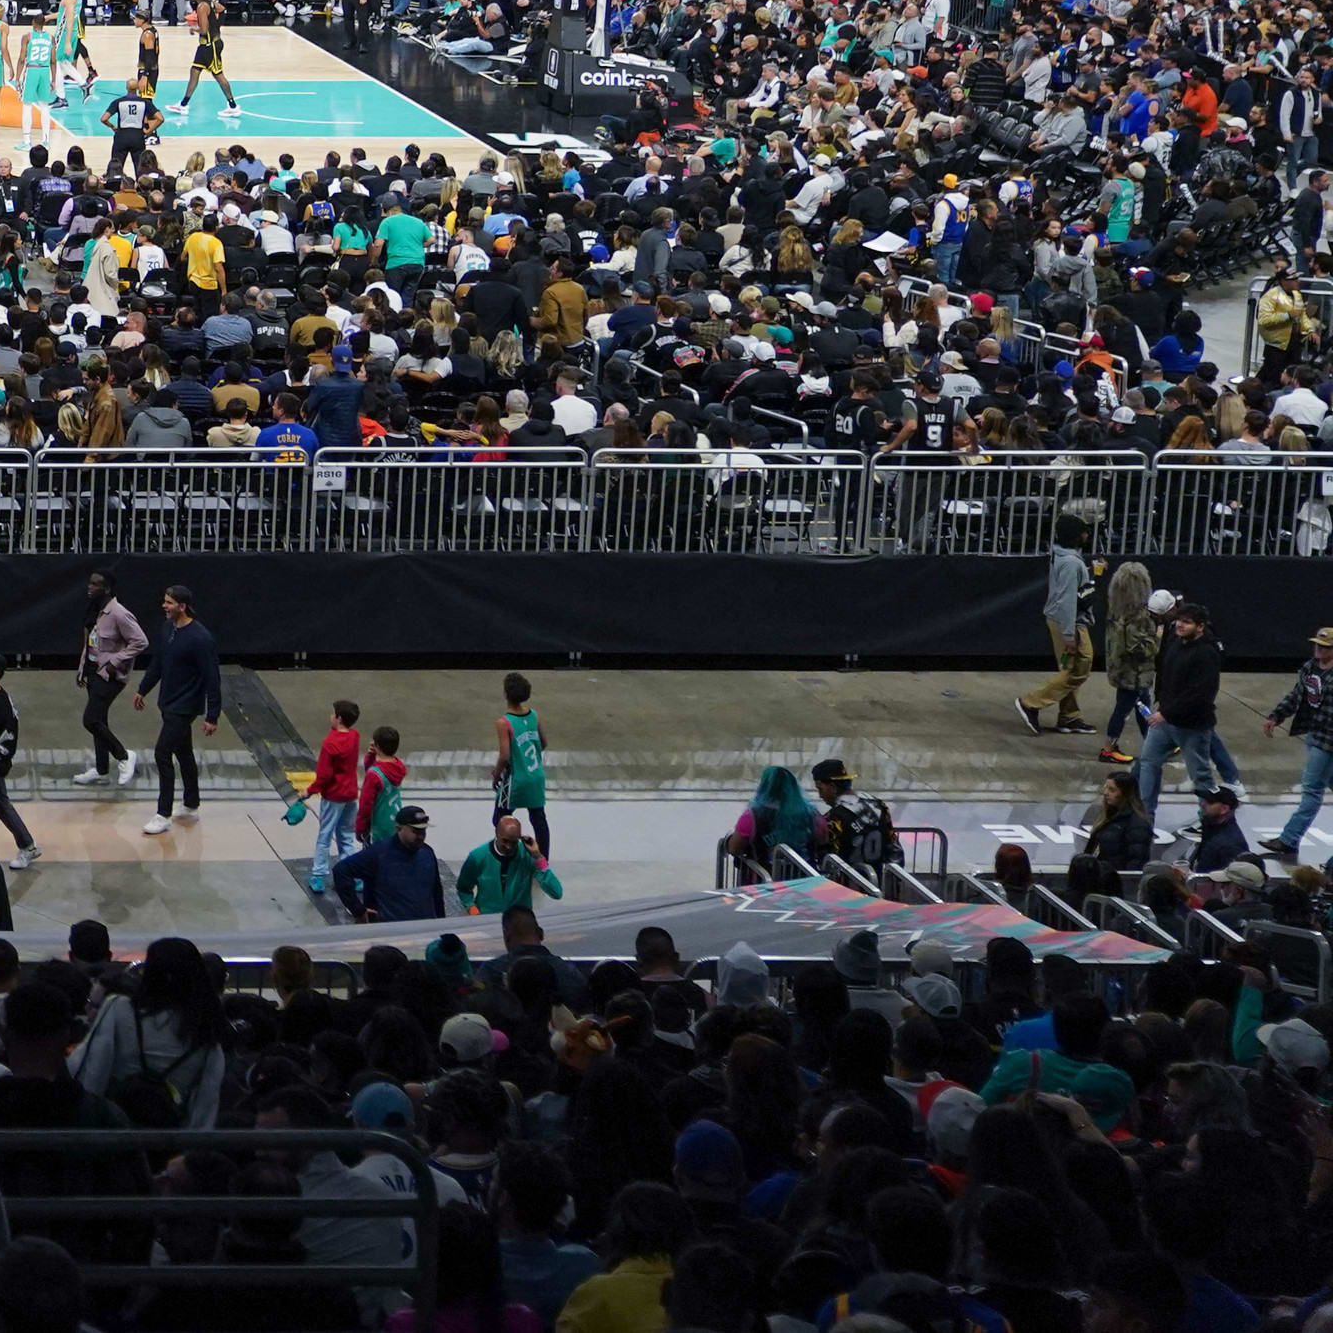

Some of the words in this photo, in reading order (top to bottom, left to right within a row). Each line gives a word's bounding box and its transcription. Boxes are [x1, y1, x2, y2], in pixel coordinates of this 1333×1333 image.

[30, 46, 50, 61] 22
[128, 104, 138, 115] 12
[146, 260, 160, 270] 30
[256, 325, 286, 336] SPURS
[834, 413, 854, 435] 20
[276, 433, 302, 444] CURRY
[925, 425, 943, 448] 9
[524, 743, 539, 773] 3
